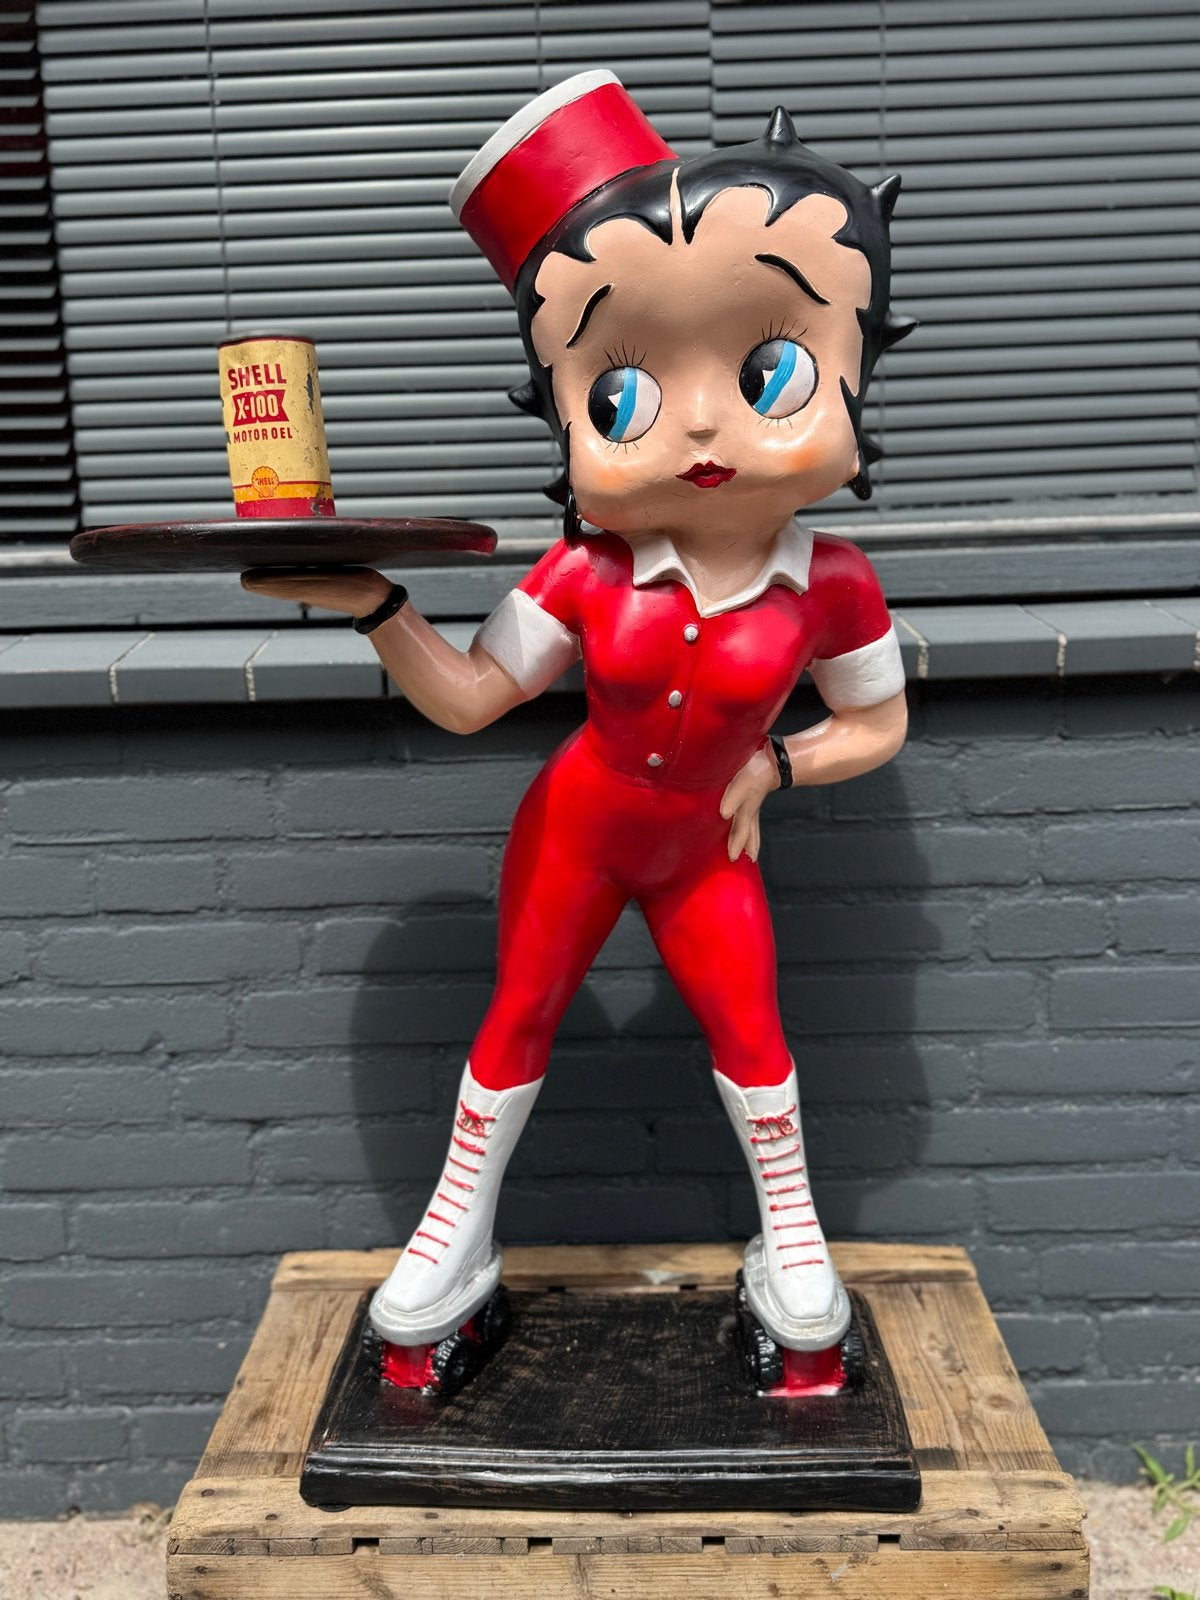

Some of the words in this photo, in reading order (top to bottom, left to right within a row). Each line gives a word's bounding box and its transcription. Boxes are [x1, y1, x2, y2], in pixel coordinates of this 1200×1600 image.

[227, 363, 287, 390] SHELL
[236, 394, 279, 420] X-100
[233, 428, 268, 444] MOTOR
[271, 427, 293, 440] OEL
